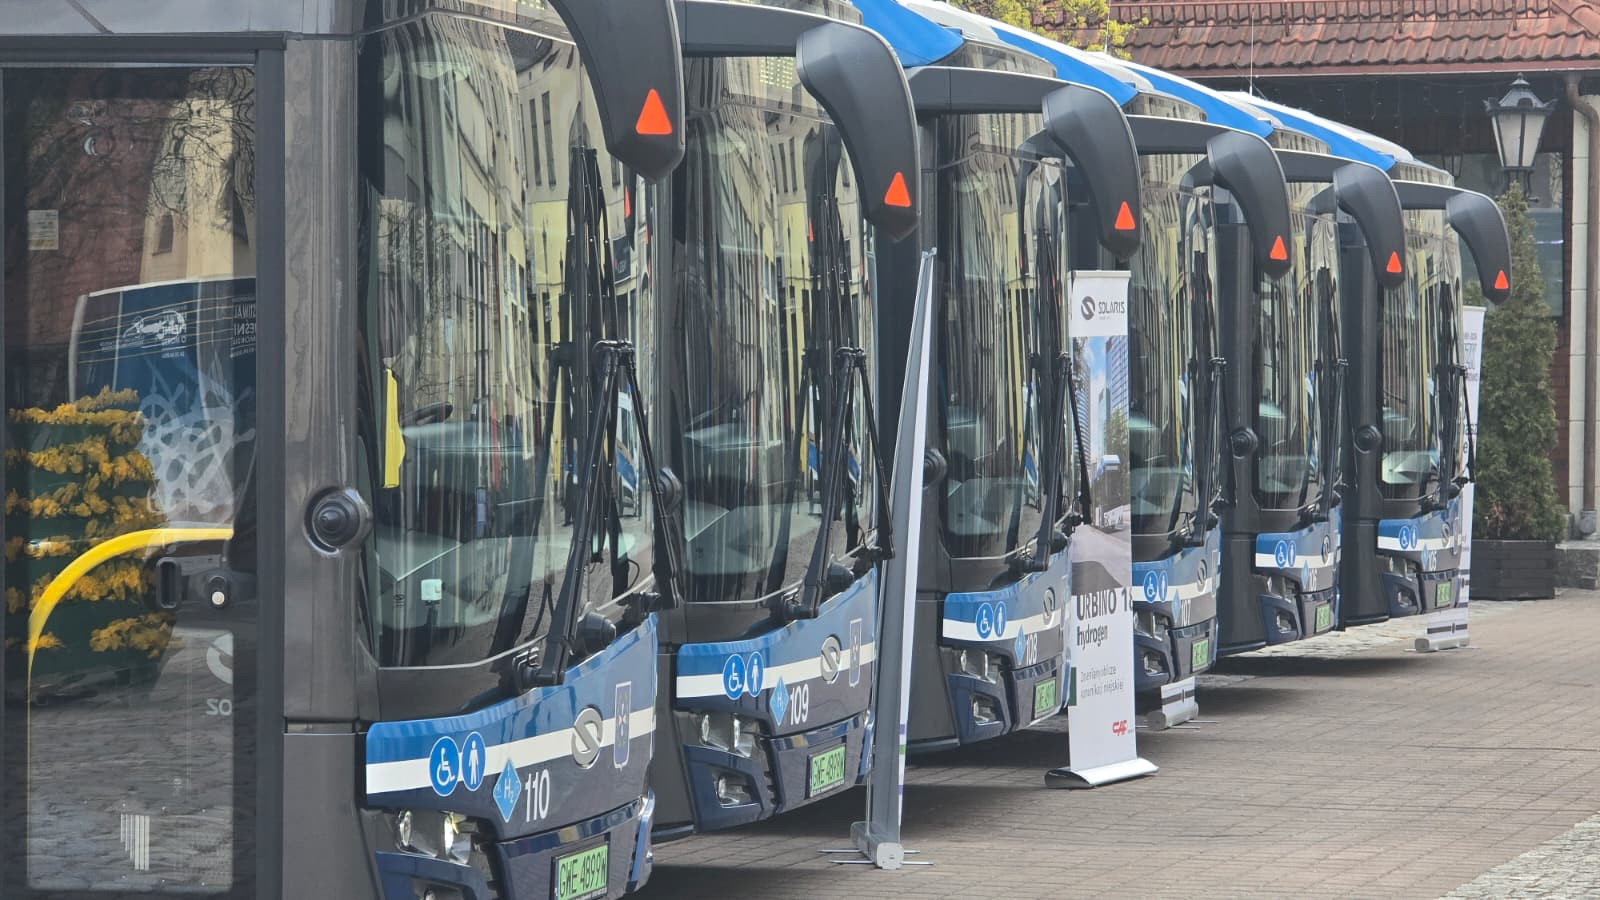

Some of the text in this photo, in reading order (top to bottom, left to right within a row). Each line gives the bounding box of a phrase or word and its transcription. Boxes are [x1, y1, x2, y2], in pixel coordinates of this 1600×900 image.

[1098, 301, 1125, 314] SOLARIS
[1077, 589, 1116, 621] URBINO
[1077, 624, 1108, 650] hydrogen
[790, 684, 809, 726] 109
[525, 769, 550, 822] 110
[560, 859, 578, 898] GWE
